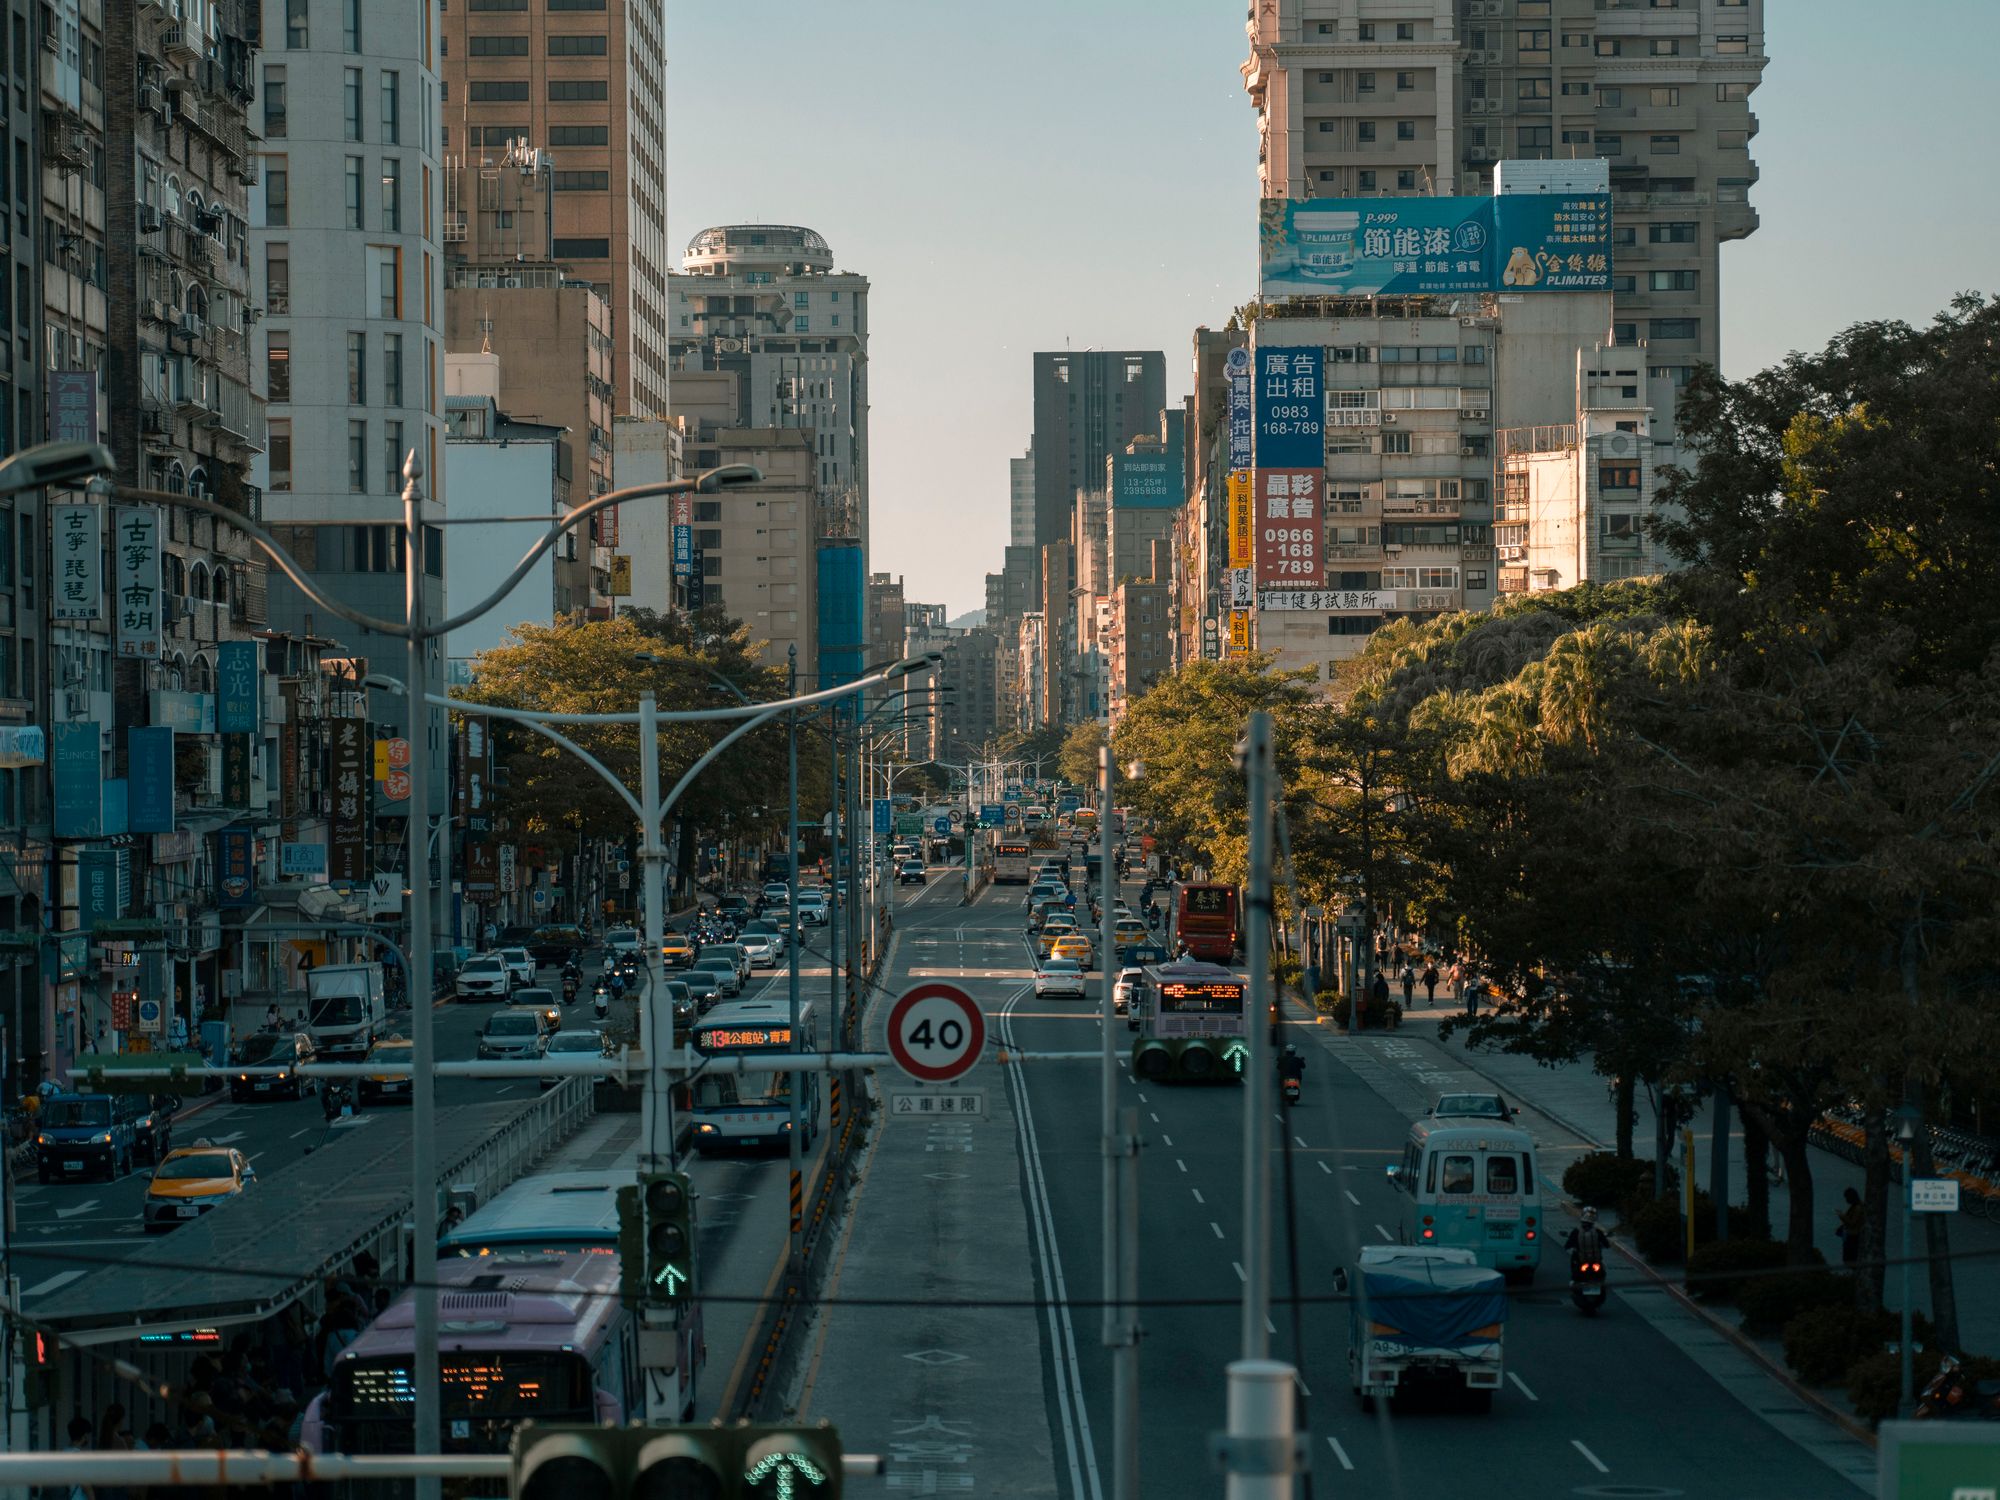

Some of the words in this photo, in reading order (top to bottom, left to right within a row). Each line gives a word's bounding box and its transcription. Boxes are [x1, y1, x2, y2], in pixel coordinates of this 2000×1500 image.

[1364, 213, 1399, 224] P-999
[1306, 233, 1353, 242] PLIMATES
[1362, 227, 1451, 256] 節能漆
[1546, 276, 1608, 285] PLIMATES
[1265, 354, 1317, 375] 廣告
[1265, 377, 1317, 399] 出租
[1271, 406, 1310, 419] 0983
[1262, 422, 1320, 436] 168-789
[1233, 454, 1251, 466] 4F
[1267, 474, 1314, 496] 晶彩
[1266, 497, 1315, 519] 廣告
[1237, 493, 1249, 558] 科見美語日語
[677, 526, 689, 560] 法語通
[1264, 528, 1315, 542] 0966
[1266, 543, 1315, 558] -168
[1266, 559, 1315, 574] -789
[1235, 570, 1250, 600] 健身
[1290, 592, 1378, 609] 健身試驗所
[225, 647, 250, 698] 志光
[908, 1018, 964, 1051] 40
[898, 1097, 978, 1113] 公車速限
